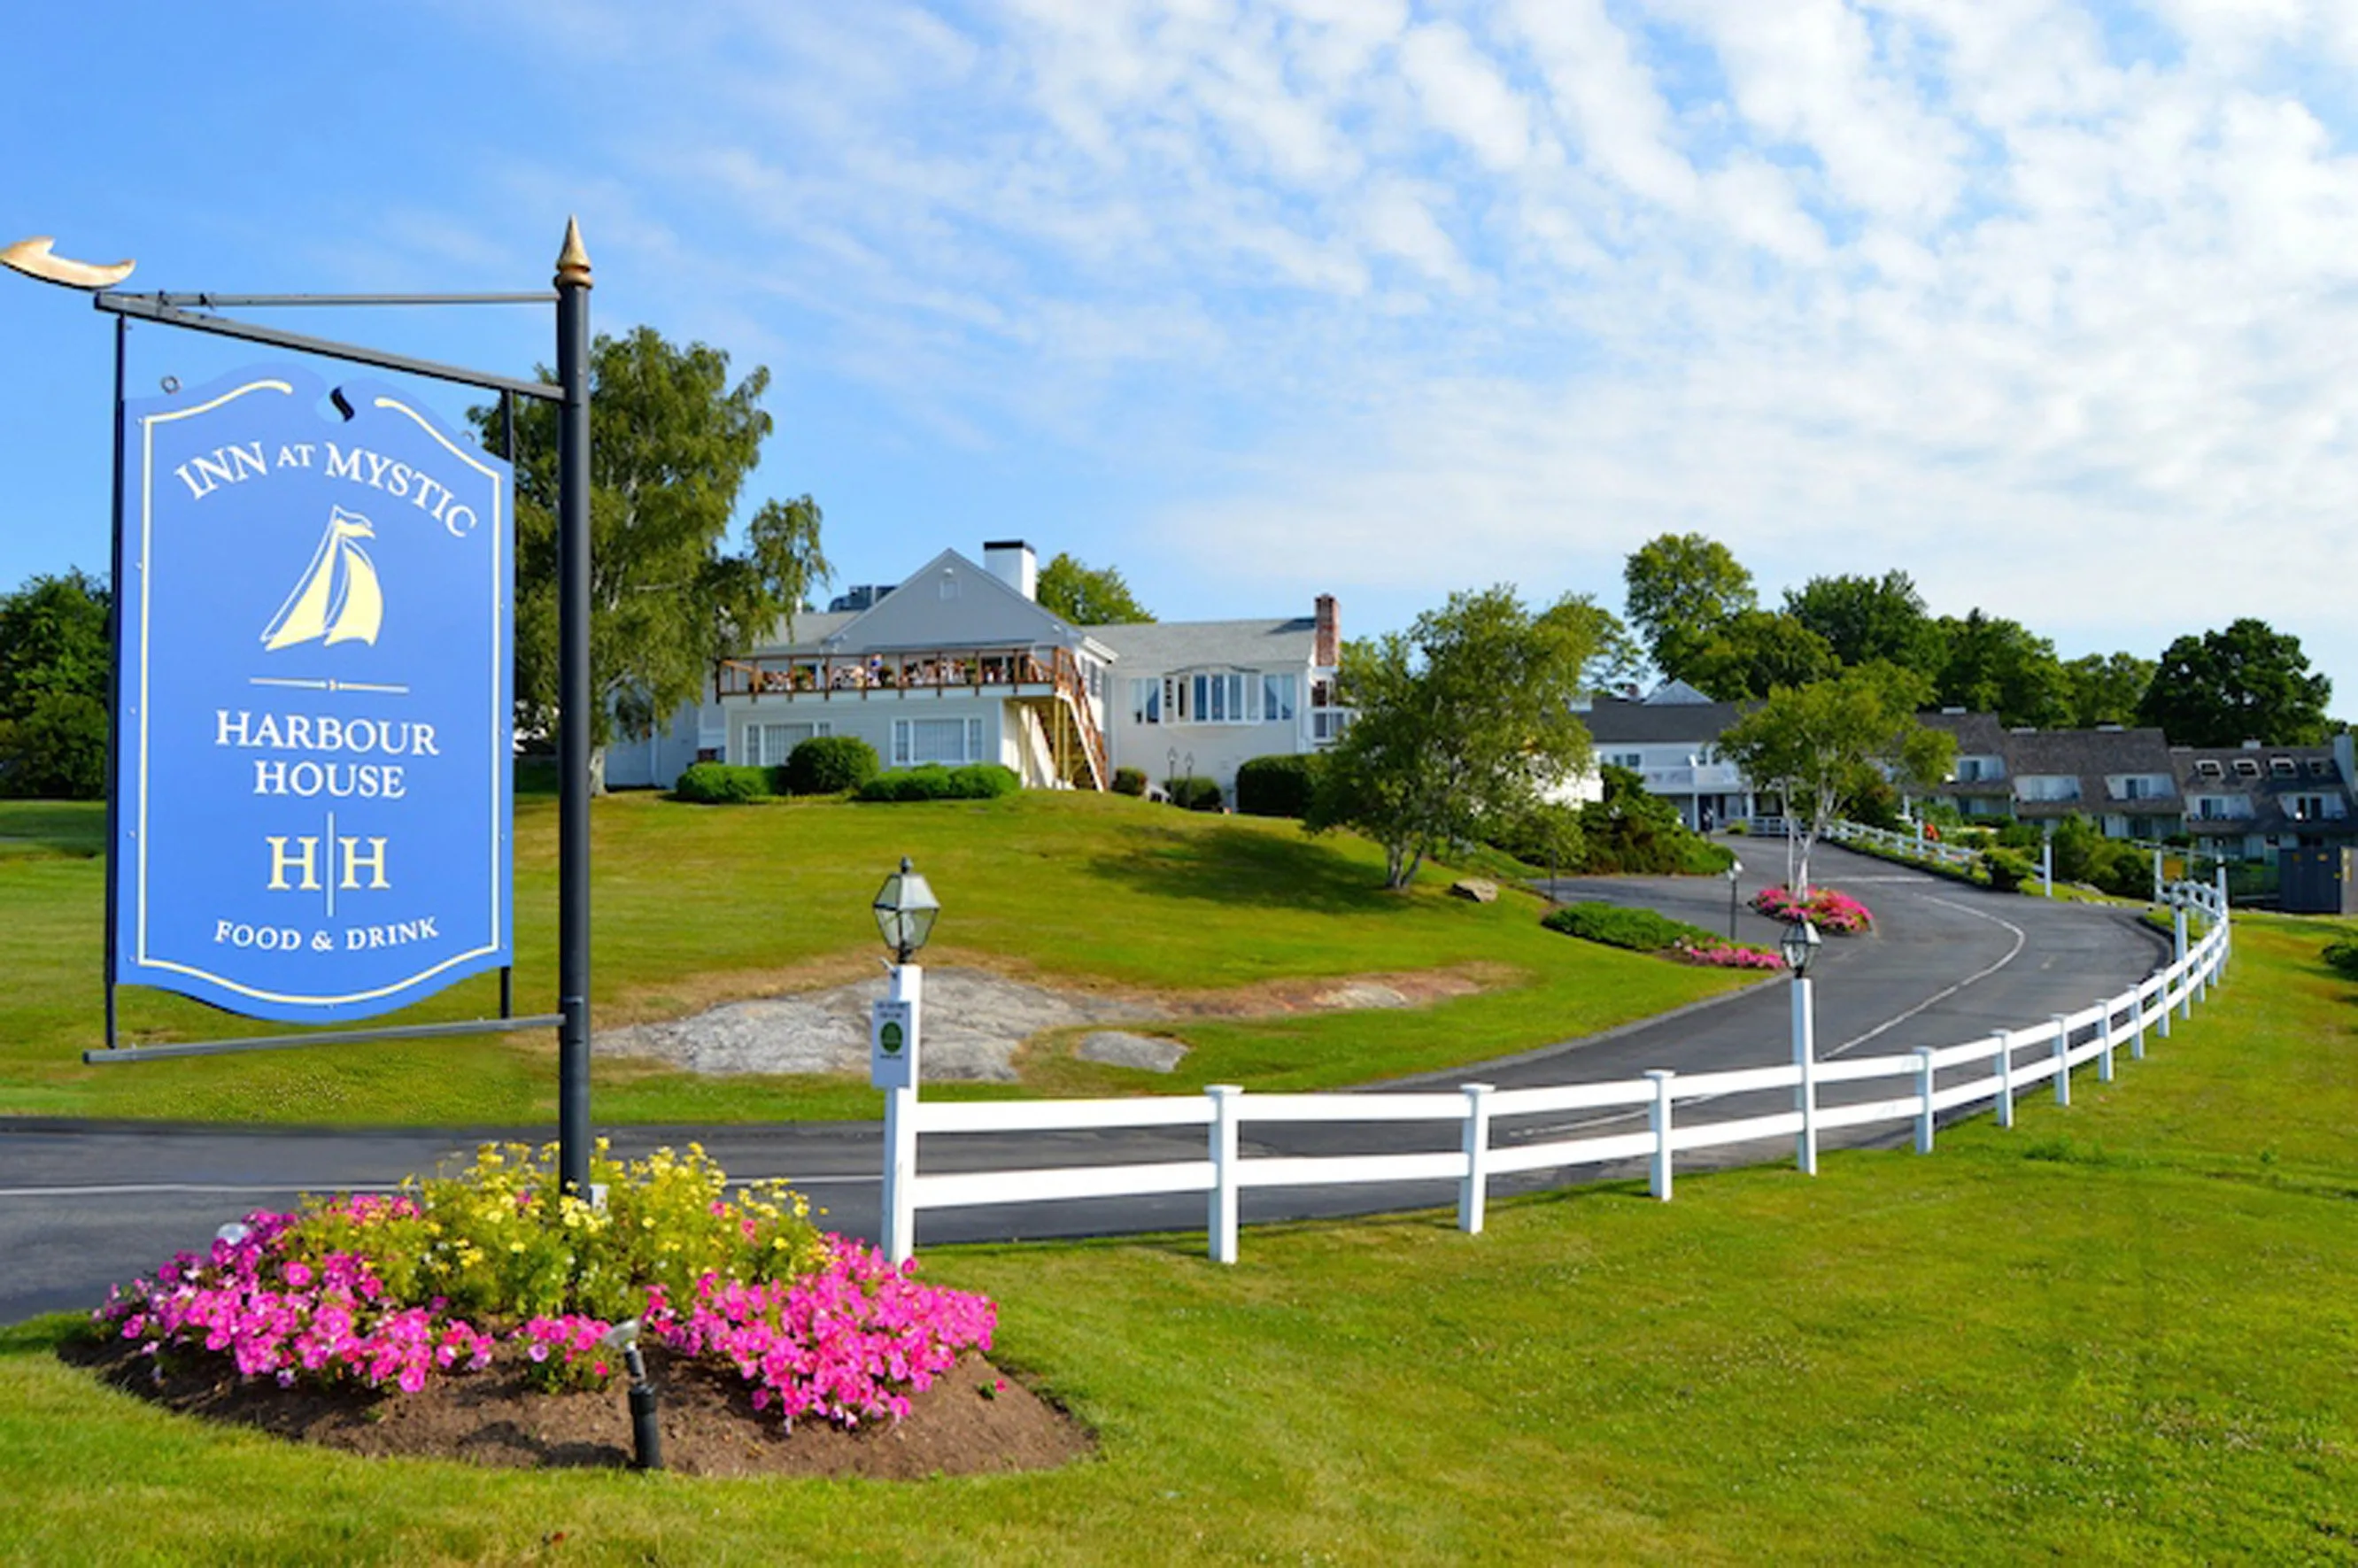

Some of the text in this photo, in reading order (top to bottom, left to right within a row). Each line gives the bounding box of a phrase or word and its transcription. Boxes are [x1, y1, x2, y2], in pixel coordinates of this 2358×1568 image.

[174, 440, 478, 538] INN AT MYSTIC
[215, 709, 440, 756] HARBOUR
[253, 761, 406, 799] HOUSE
[214, 916, 440, 951] FOOD & DRINK
